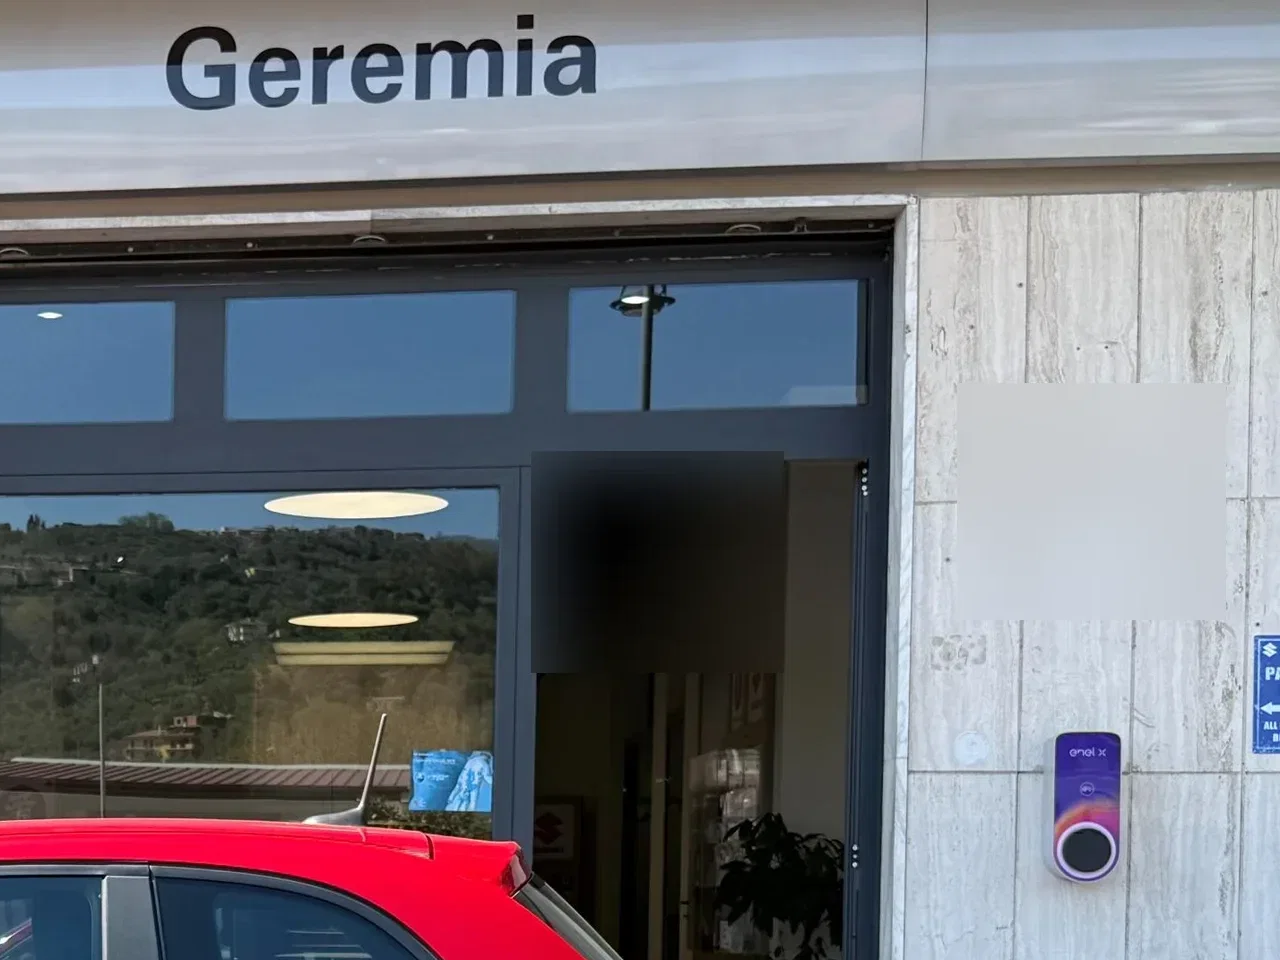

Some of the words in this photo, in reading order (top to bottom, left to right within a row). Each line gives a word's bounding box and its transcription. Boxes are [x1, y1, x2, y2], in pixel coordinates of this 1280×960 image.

[165, 14, 597, 111] Geremia
[1263, 721, 1278, 730] ALL
[1069, 746, 1095, 757] enel
